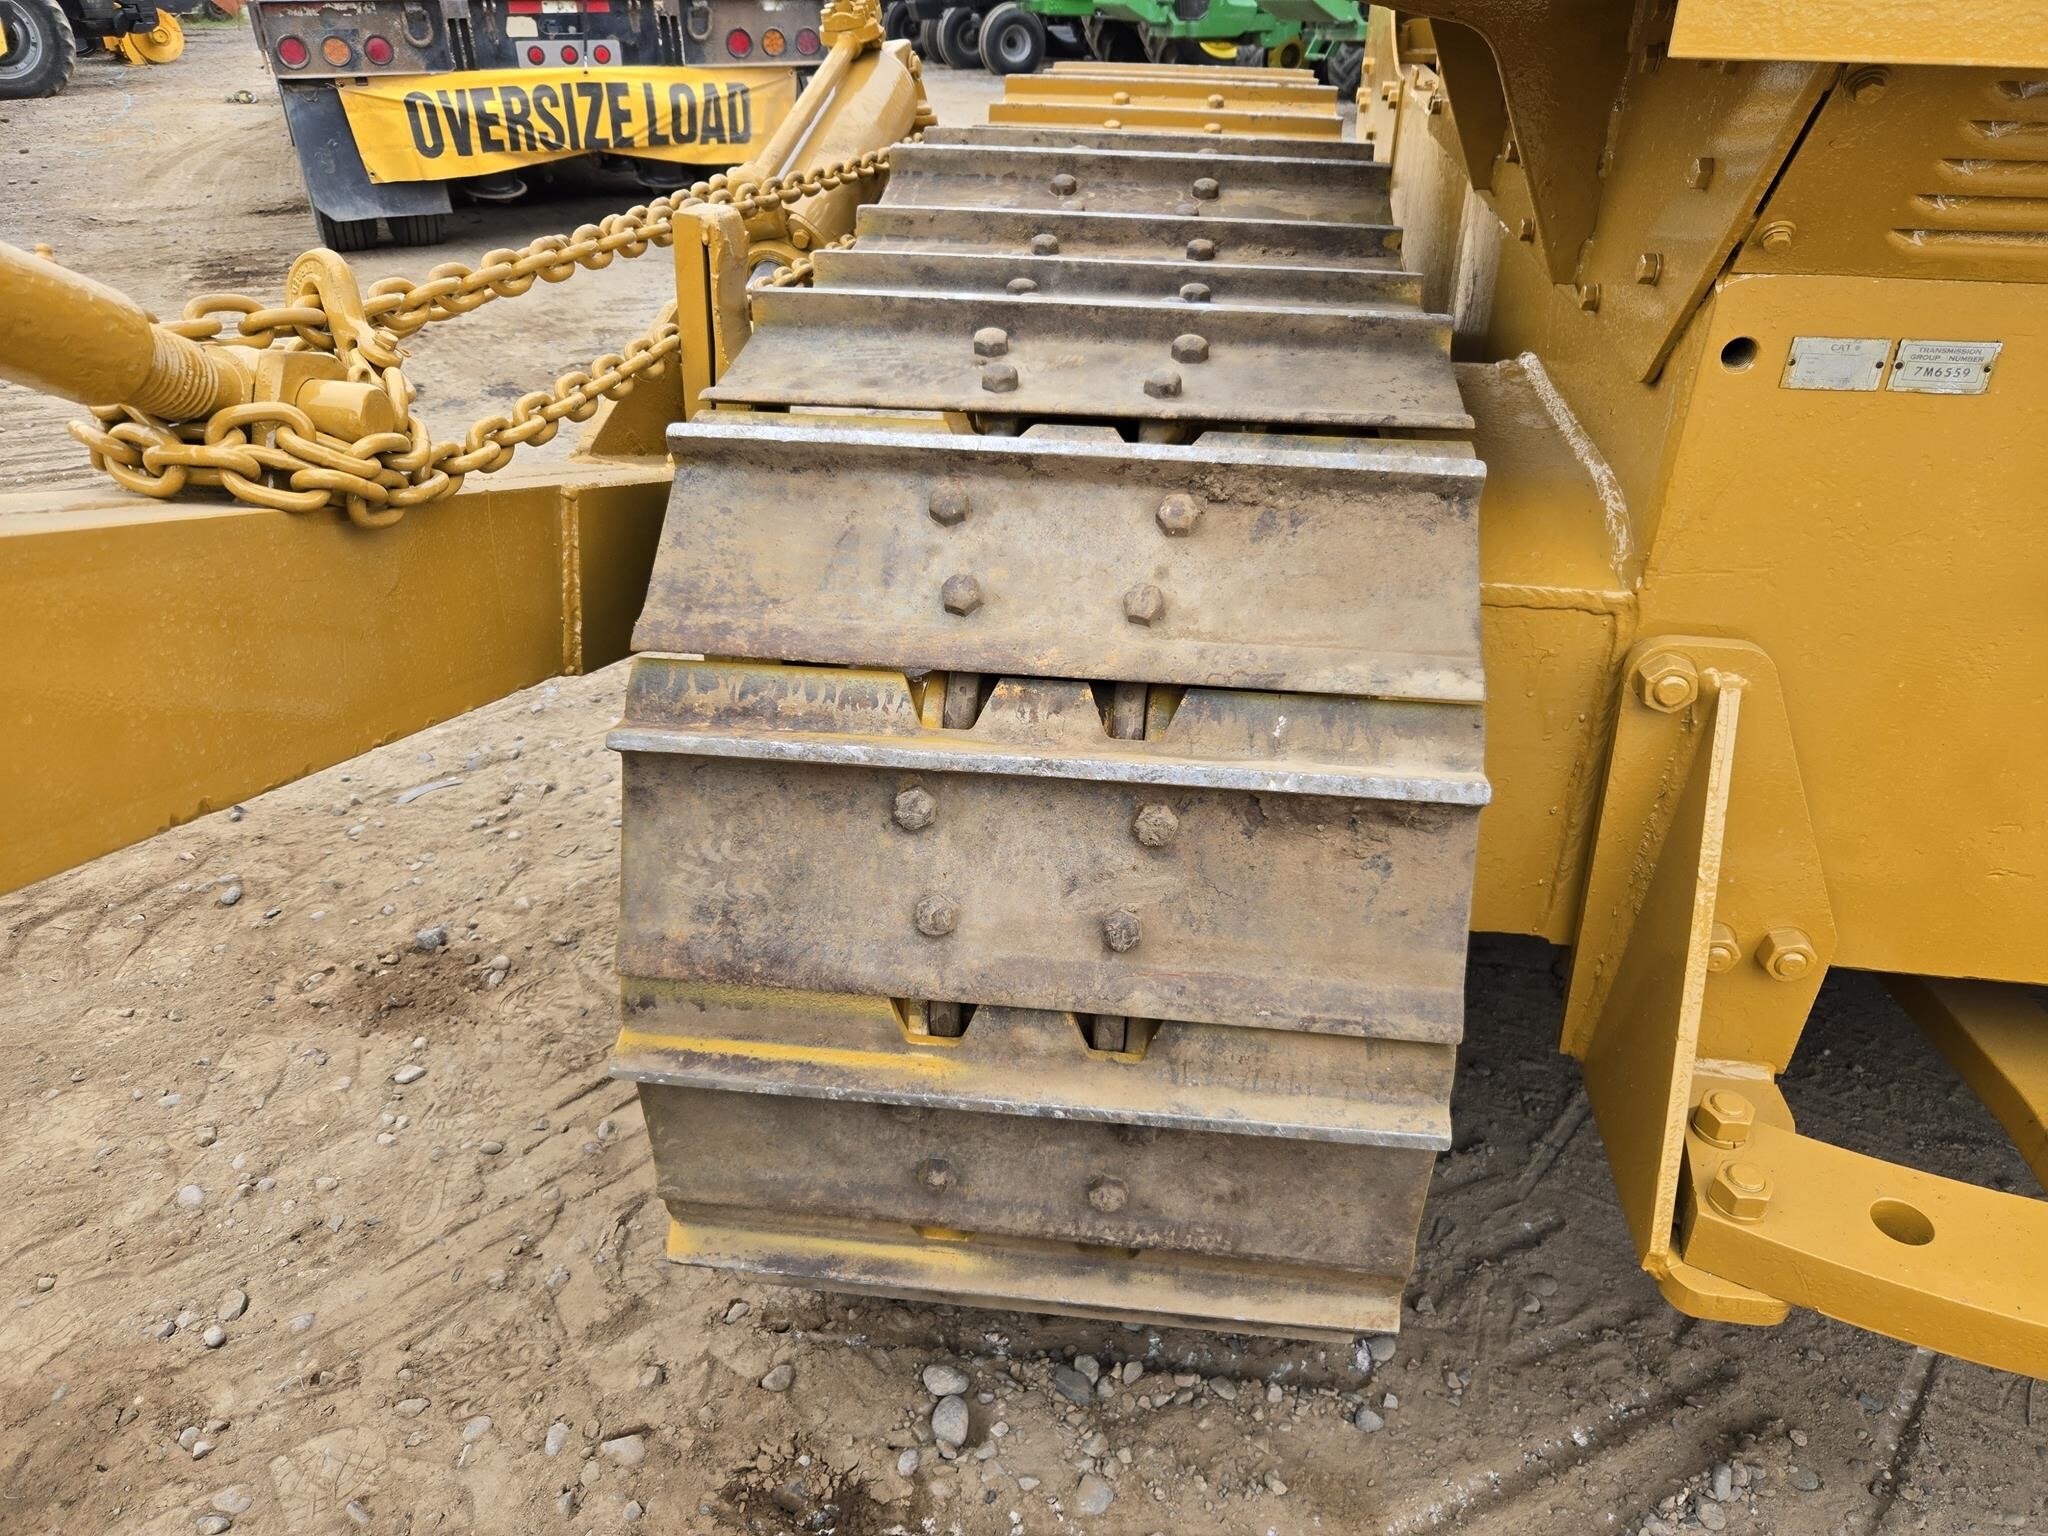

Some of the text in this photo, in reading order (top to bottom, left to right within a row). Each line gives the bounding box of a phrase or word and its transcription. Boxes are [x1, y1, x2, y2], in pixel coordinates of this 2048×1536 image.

[403, 82, 751, 159] OVERSIZE LOAD
[1919, 347, 1983, 355] TRANSMISSION
[1914, 366, 1971, 378] 7M6559
